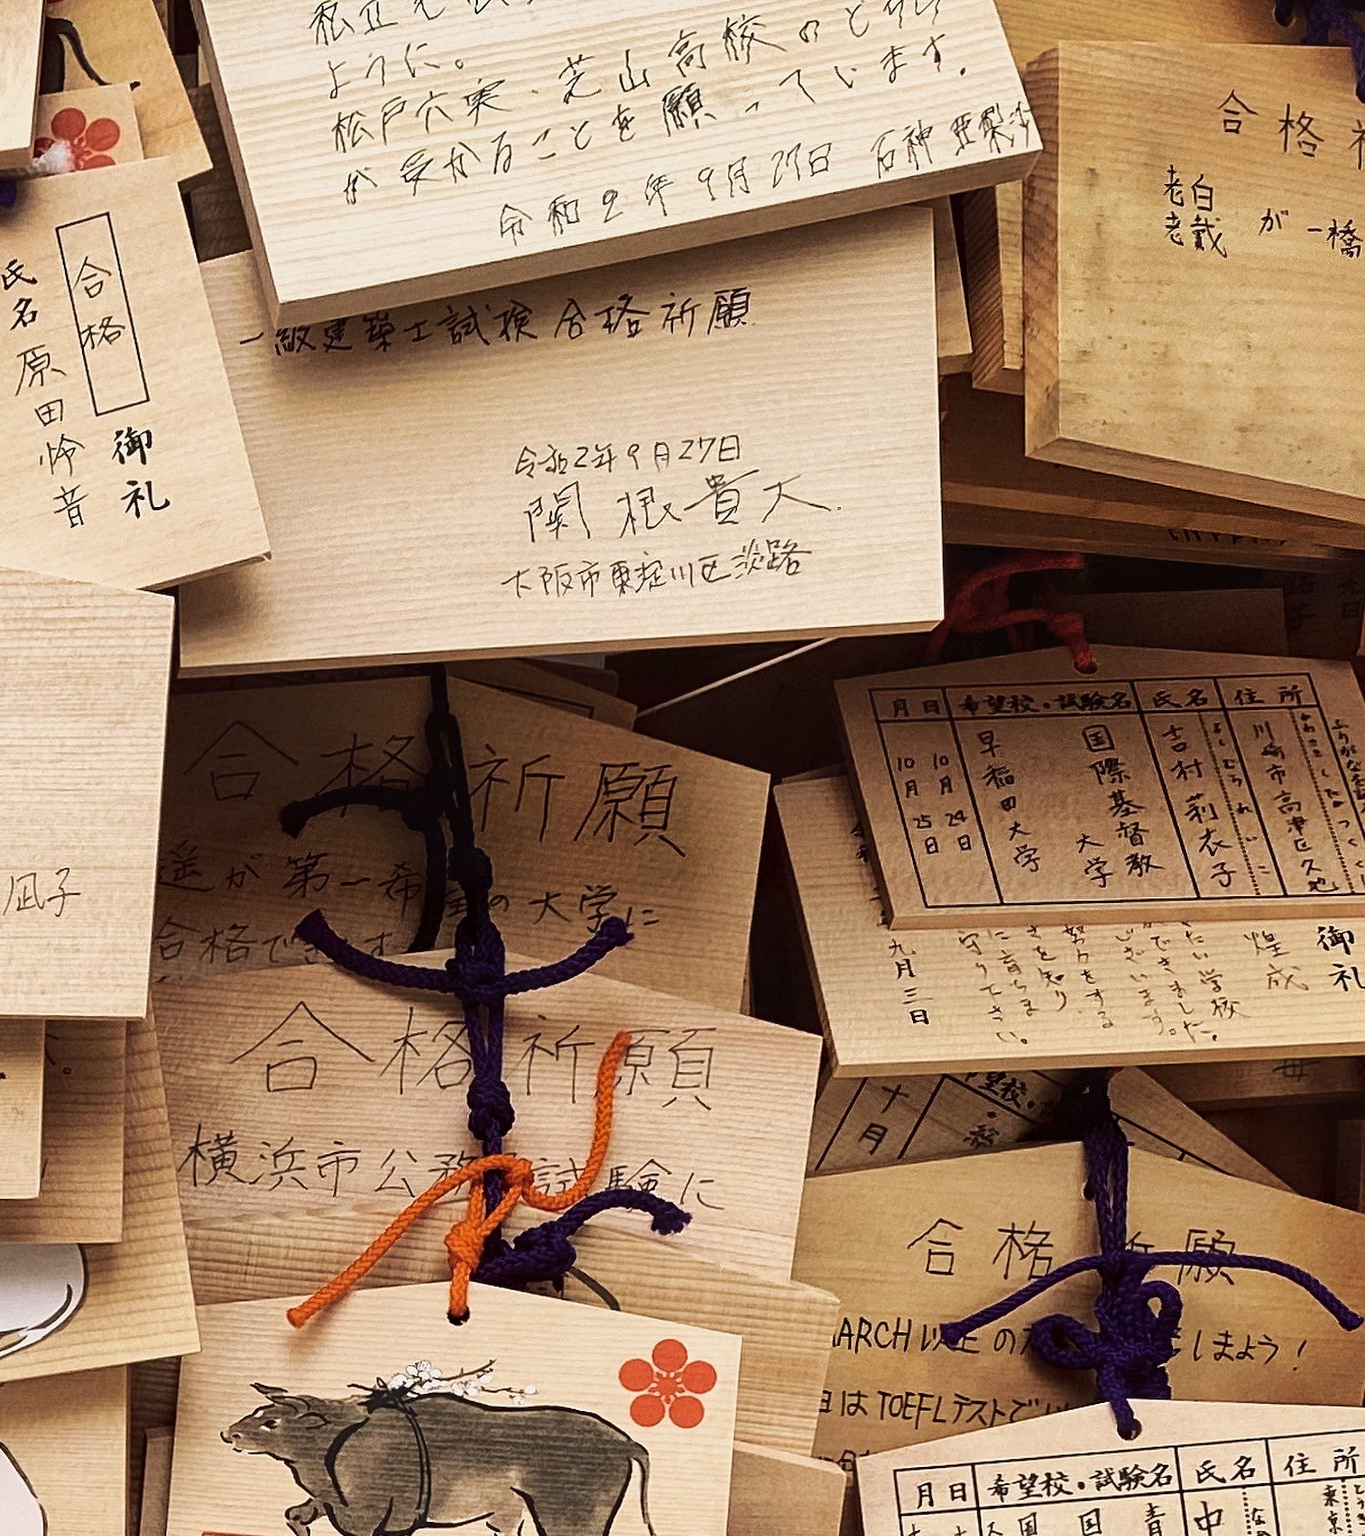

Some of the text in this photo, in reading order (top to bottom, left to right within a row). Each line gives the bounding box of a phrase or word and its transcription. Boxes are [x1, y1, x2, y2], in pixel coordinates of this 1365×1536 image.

[1, 259, 37, 326] 氏名
[113, 427, 170, 517] 御礼
[916, 1481, 967, 1509] 月日
[1196, 1457, 1256, 1485] 氏名
[1284, 1446, 1360, 1477] 住所
